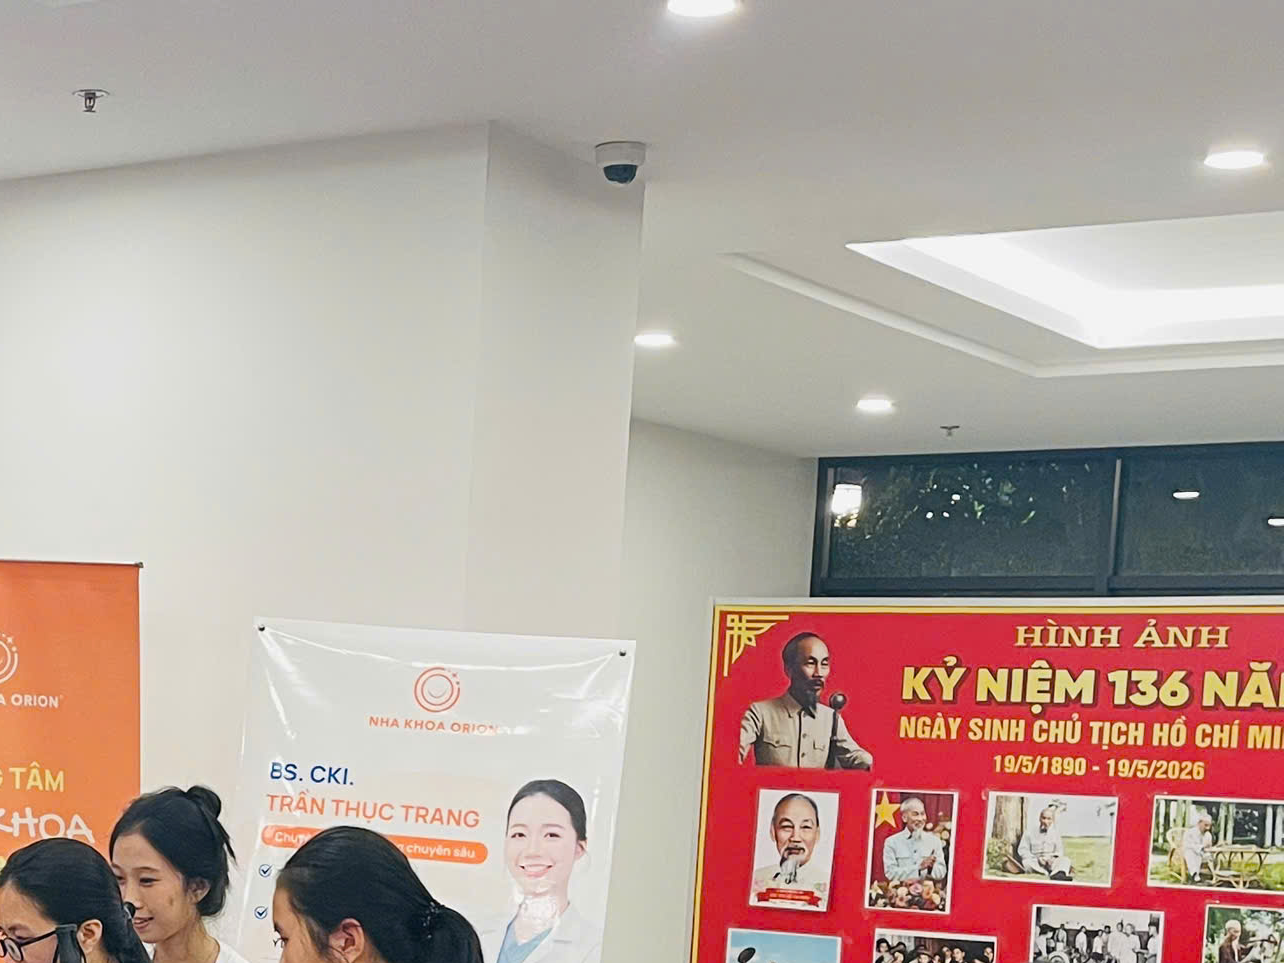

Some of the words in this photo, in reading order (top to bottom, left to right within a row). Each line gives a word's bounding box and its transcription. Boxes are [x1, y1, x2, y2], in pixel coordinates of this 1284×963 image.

[1014, 619, 1121, 647] HÌNH
[1133, 619, 1230, 648] ẢNH
[902, 656, 967, 701] KỶ
[976, 659, 1095, 714] NIỆM
[1107, 670, 1190, 707] 136
[11, 693, 59, 709] ORION
[369, 716, 399, 729] NHA
[404, 719, 445, 731] KHOA
[899, 712, 962, 740] NGÀY
[968, 718, 1026, 742] SINH
[1032, 713, 1082, 744] CHỦ
[1089, 721, 1145, 750] TỊCH
[1152, 716, 1187, 748] HỒ
[1195, 720, 1240, 749] CHÍ
[9, 761, 64, 792] TÂM
[270, 762, 303, 782] BS.
[994, 755, 1087, 776] 19/5/1890
[1107, 758, 1205, 780] 19/5/2026
[267, 788, 325, 816] TRẦN
[331, 798, 395, 826] THỤC
[401, 804, 480, 828] TRANG
[406, 844, 451, 858] chuyên
